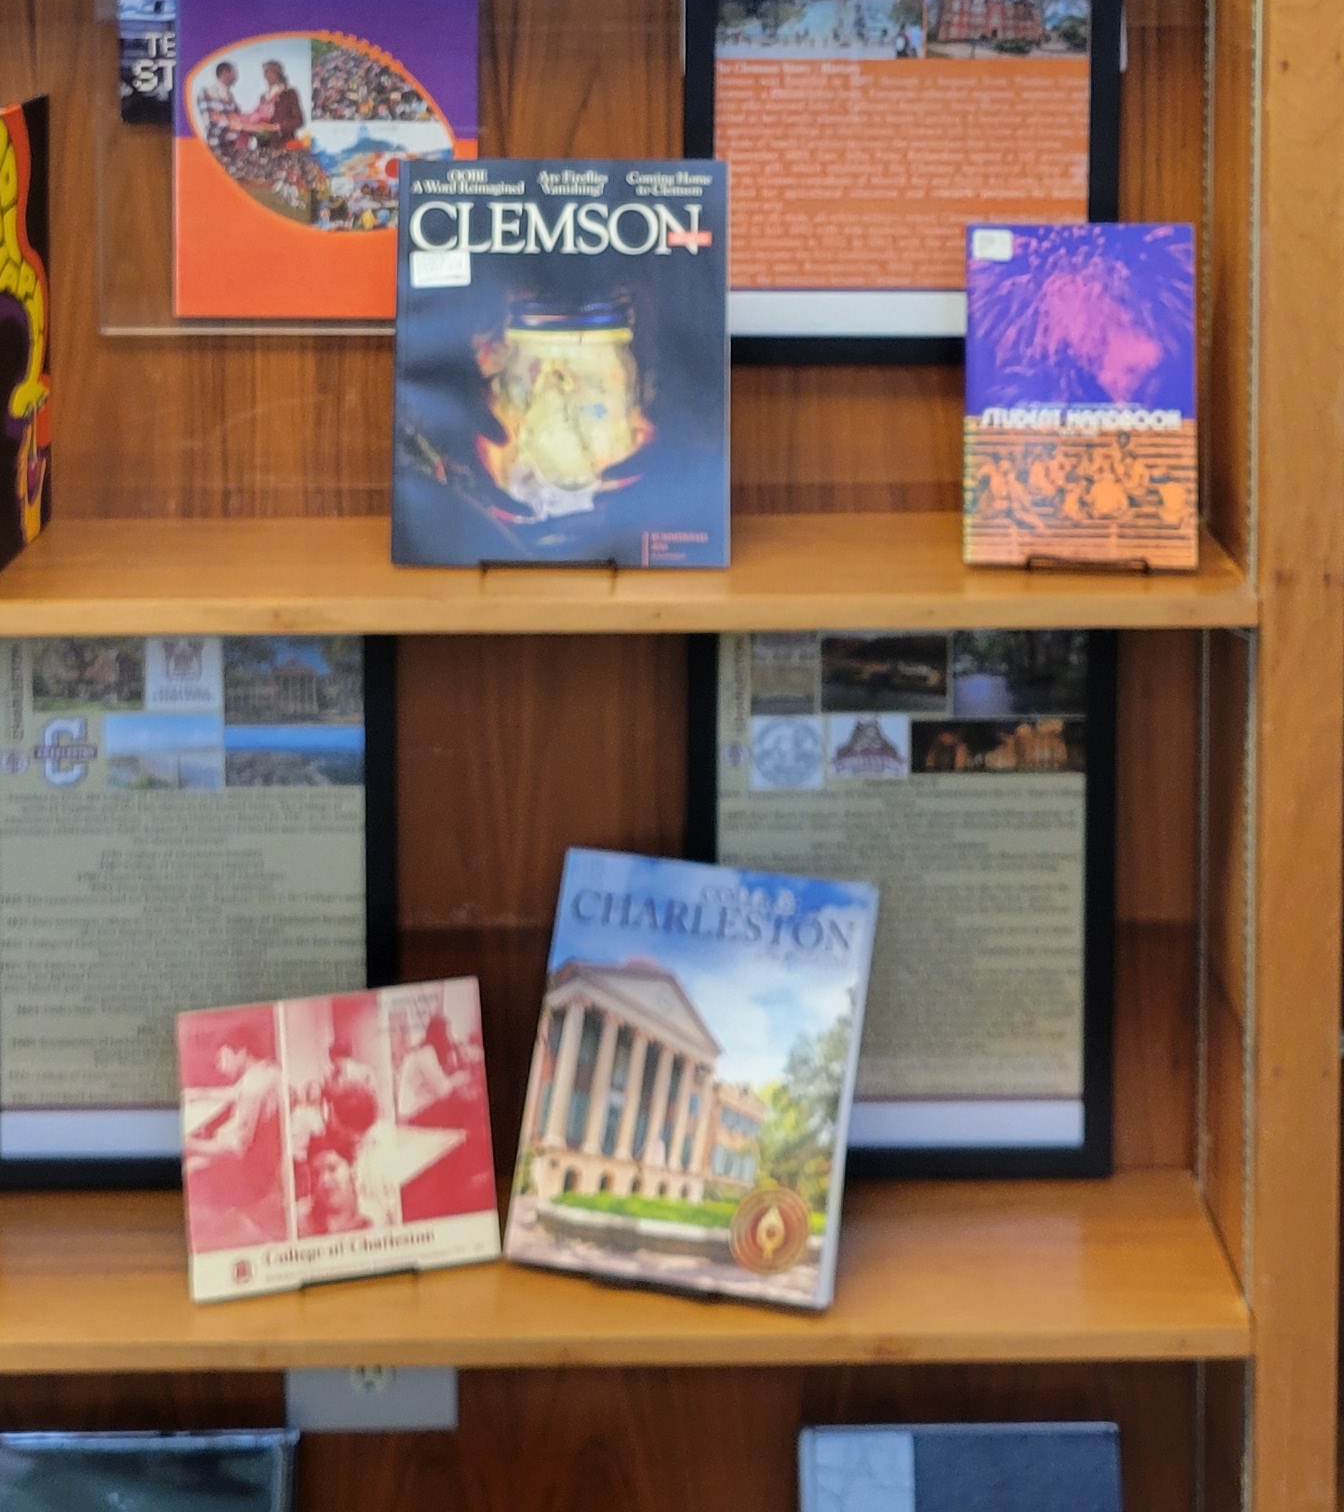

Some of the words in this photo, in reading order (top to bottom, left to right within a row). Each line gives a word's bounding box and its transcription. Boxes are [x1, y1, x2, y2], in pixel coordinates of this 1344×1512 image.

[459, 181, 525, 195] Reimagined
[538, 170, 560, 183] Are
[562, 170, 609, 183] Fireflies
[626, 171, 674, 185] Coming
[676, 172, 712, 185] Home
[409, 201, 703, 255] CLEMSON
[572, 888, 853, 951] CHARLESTON
[266, 1248, 320, 1265] College
[351, 1232, 435, 1253] Charleston
